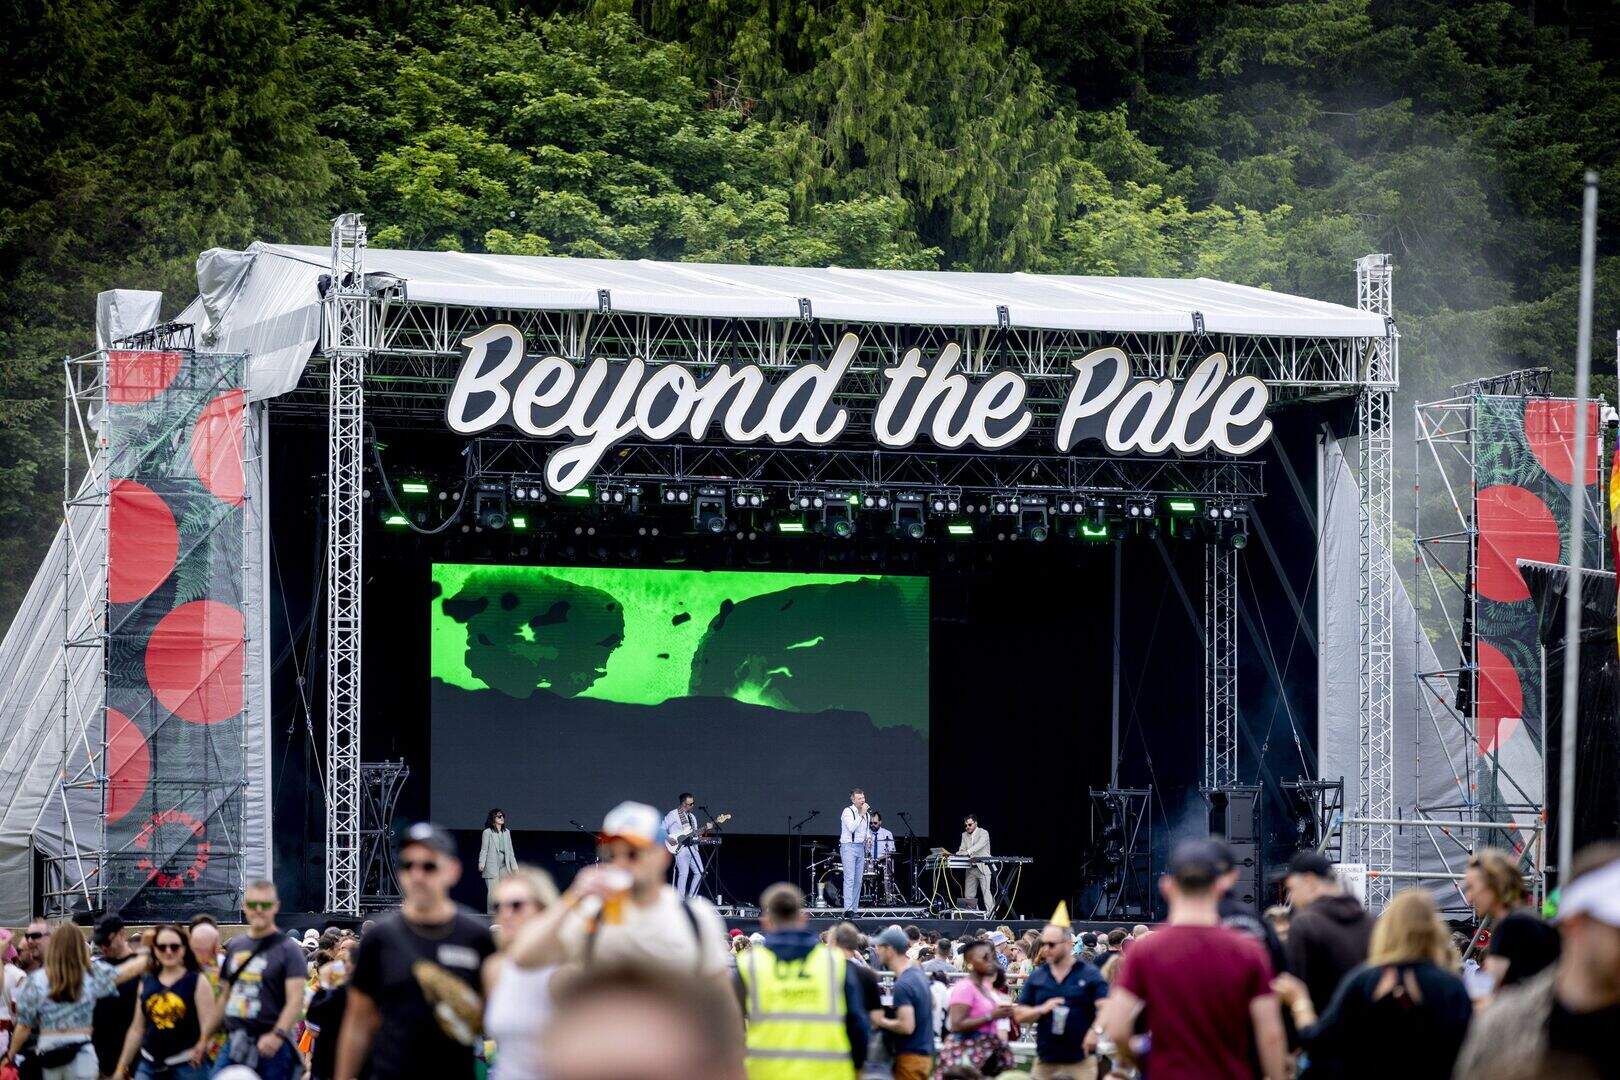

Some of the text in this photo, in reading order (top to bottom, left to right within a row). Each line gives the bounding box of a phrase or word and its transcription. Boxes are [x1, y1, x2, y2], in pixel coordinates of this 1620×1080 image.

[446, 323, 1273, 492] Beyond the Pale
